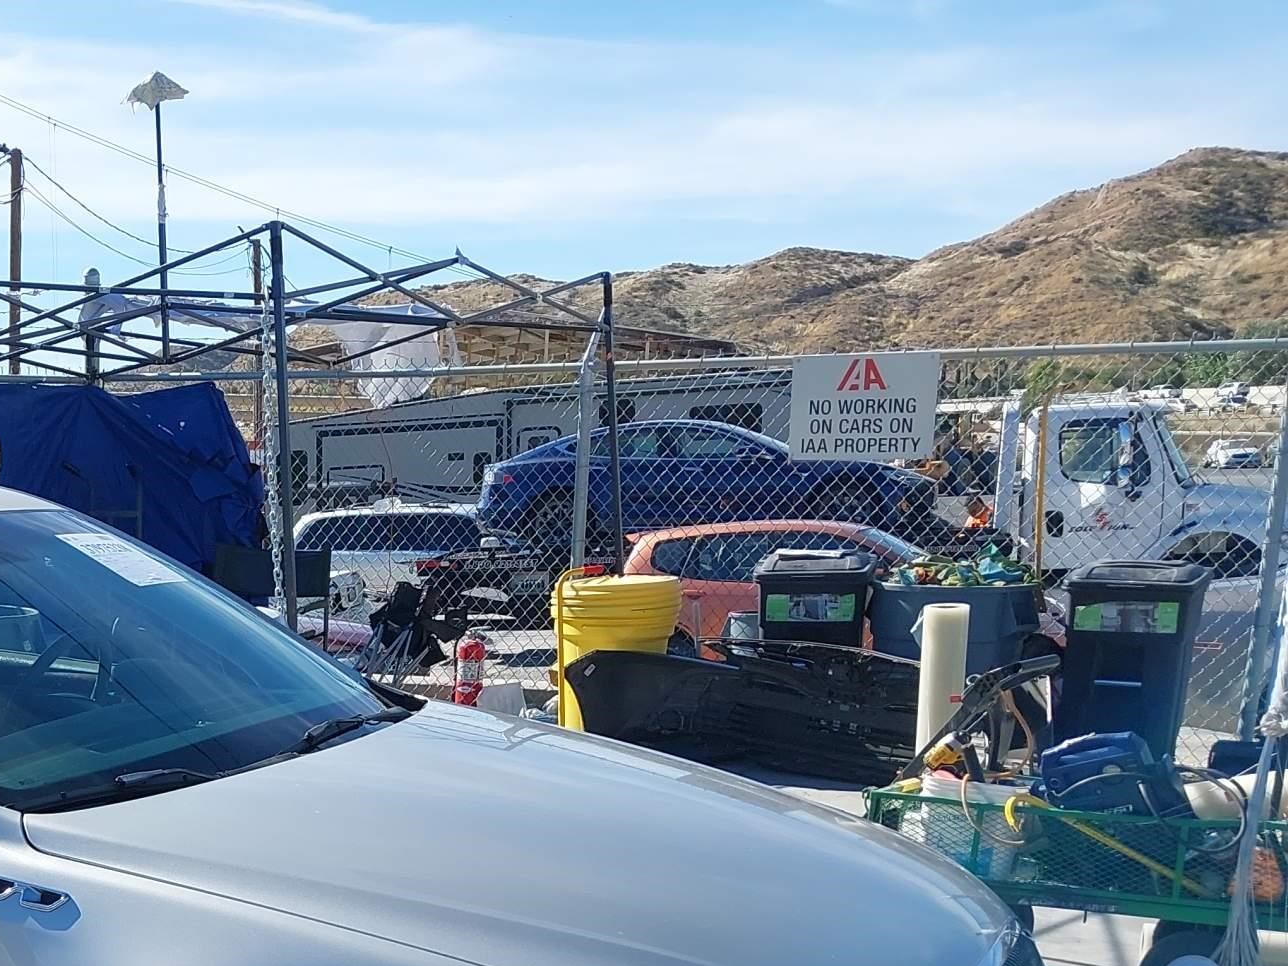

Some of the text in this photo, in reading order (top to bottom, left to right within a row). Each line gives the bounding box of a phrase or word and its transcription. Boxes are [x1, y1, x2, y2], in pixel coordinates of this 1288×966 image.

[809, 398, 917, 415] NO WORKING
[809, 417, 913, 435] ON CARS ON
[800, 437, 921, 454] IAA PROPERTY
